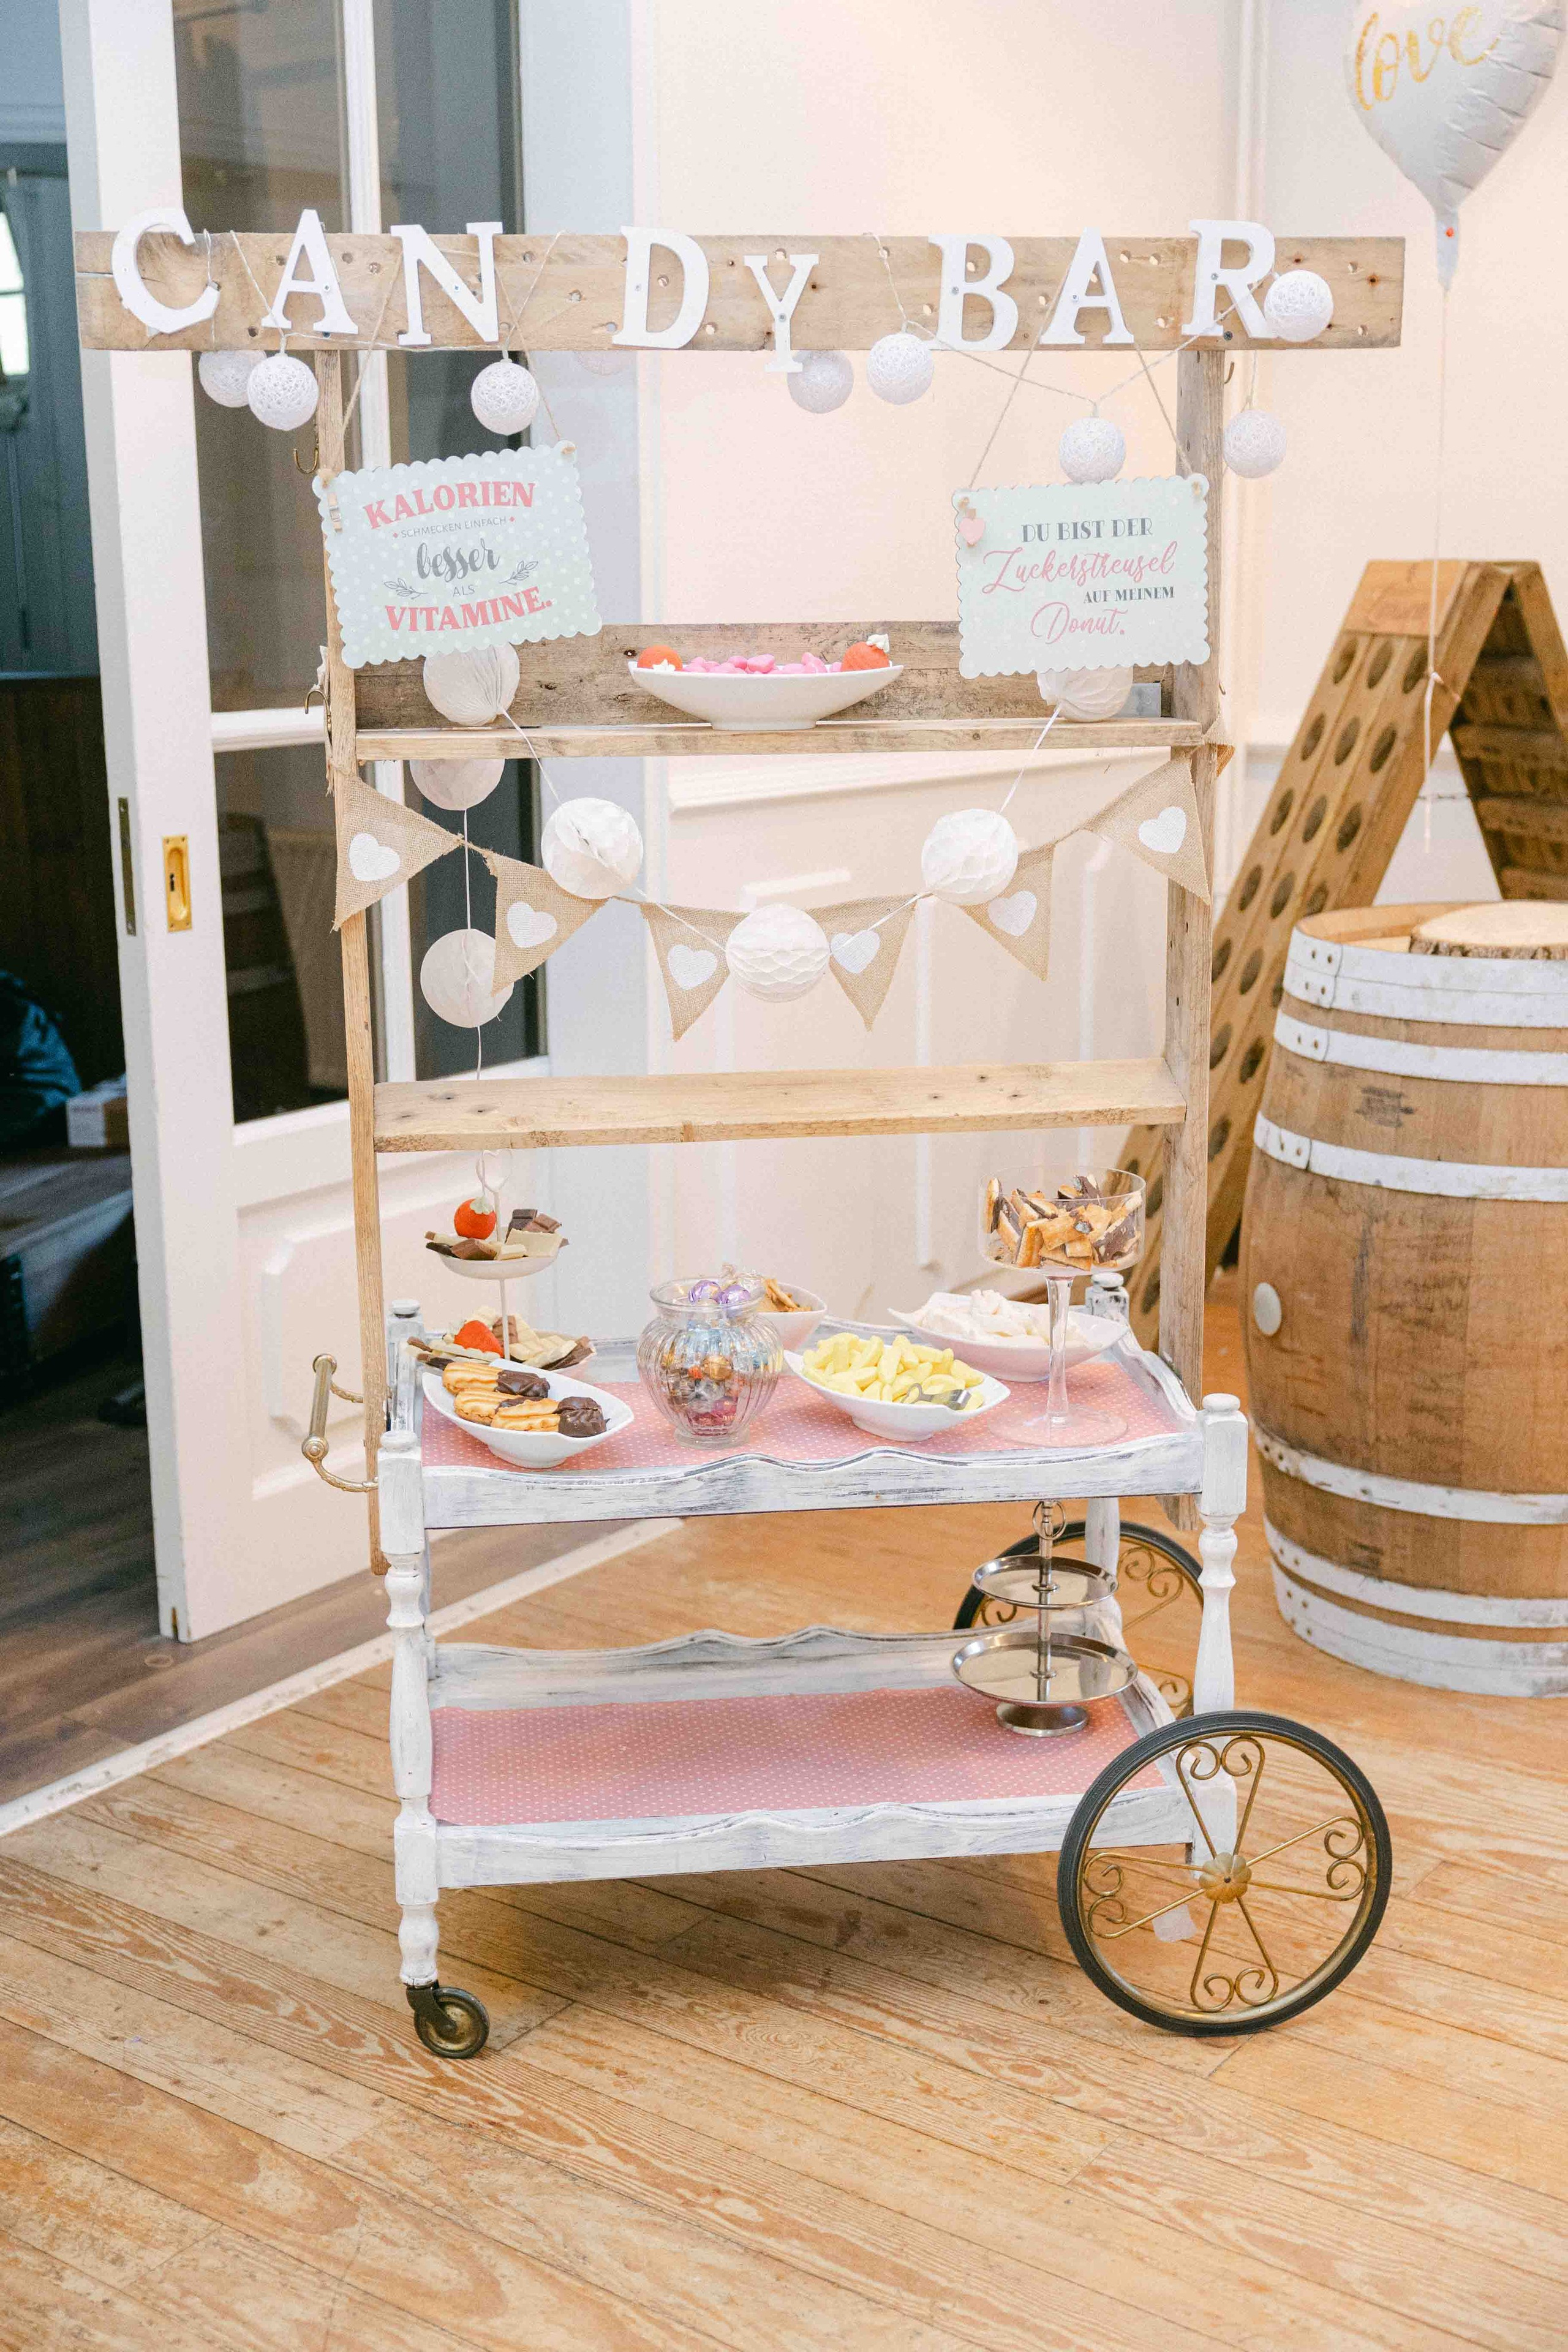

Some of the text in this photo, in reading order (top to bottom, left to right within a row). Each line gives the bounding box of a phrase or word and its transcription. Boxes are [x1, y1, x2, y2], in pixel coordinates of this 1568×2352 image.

[929, 219, 1279, 352] BAR
[363, 481, 535, 530] KALORIEN
[401, 516, 507, 538] SCHMECKEN EINFACH
[1022, 517, 1153, 542] DU BIST DER
[416, 538, 500, 582] besser
[982, 541, 1178, 594] Zuckerstreusel
[385, 586, 553, 631] VITAMINE.
[453, 584, 475, 597] ALS
[1084, 586, 1174, 604] AUF MEINEM
[1031, 601, 1128, 644] Donut.
